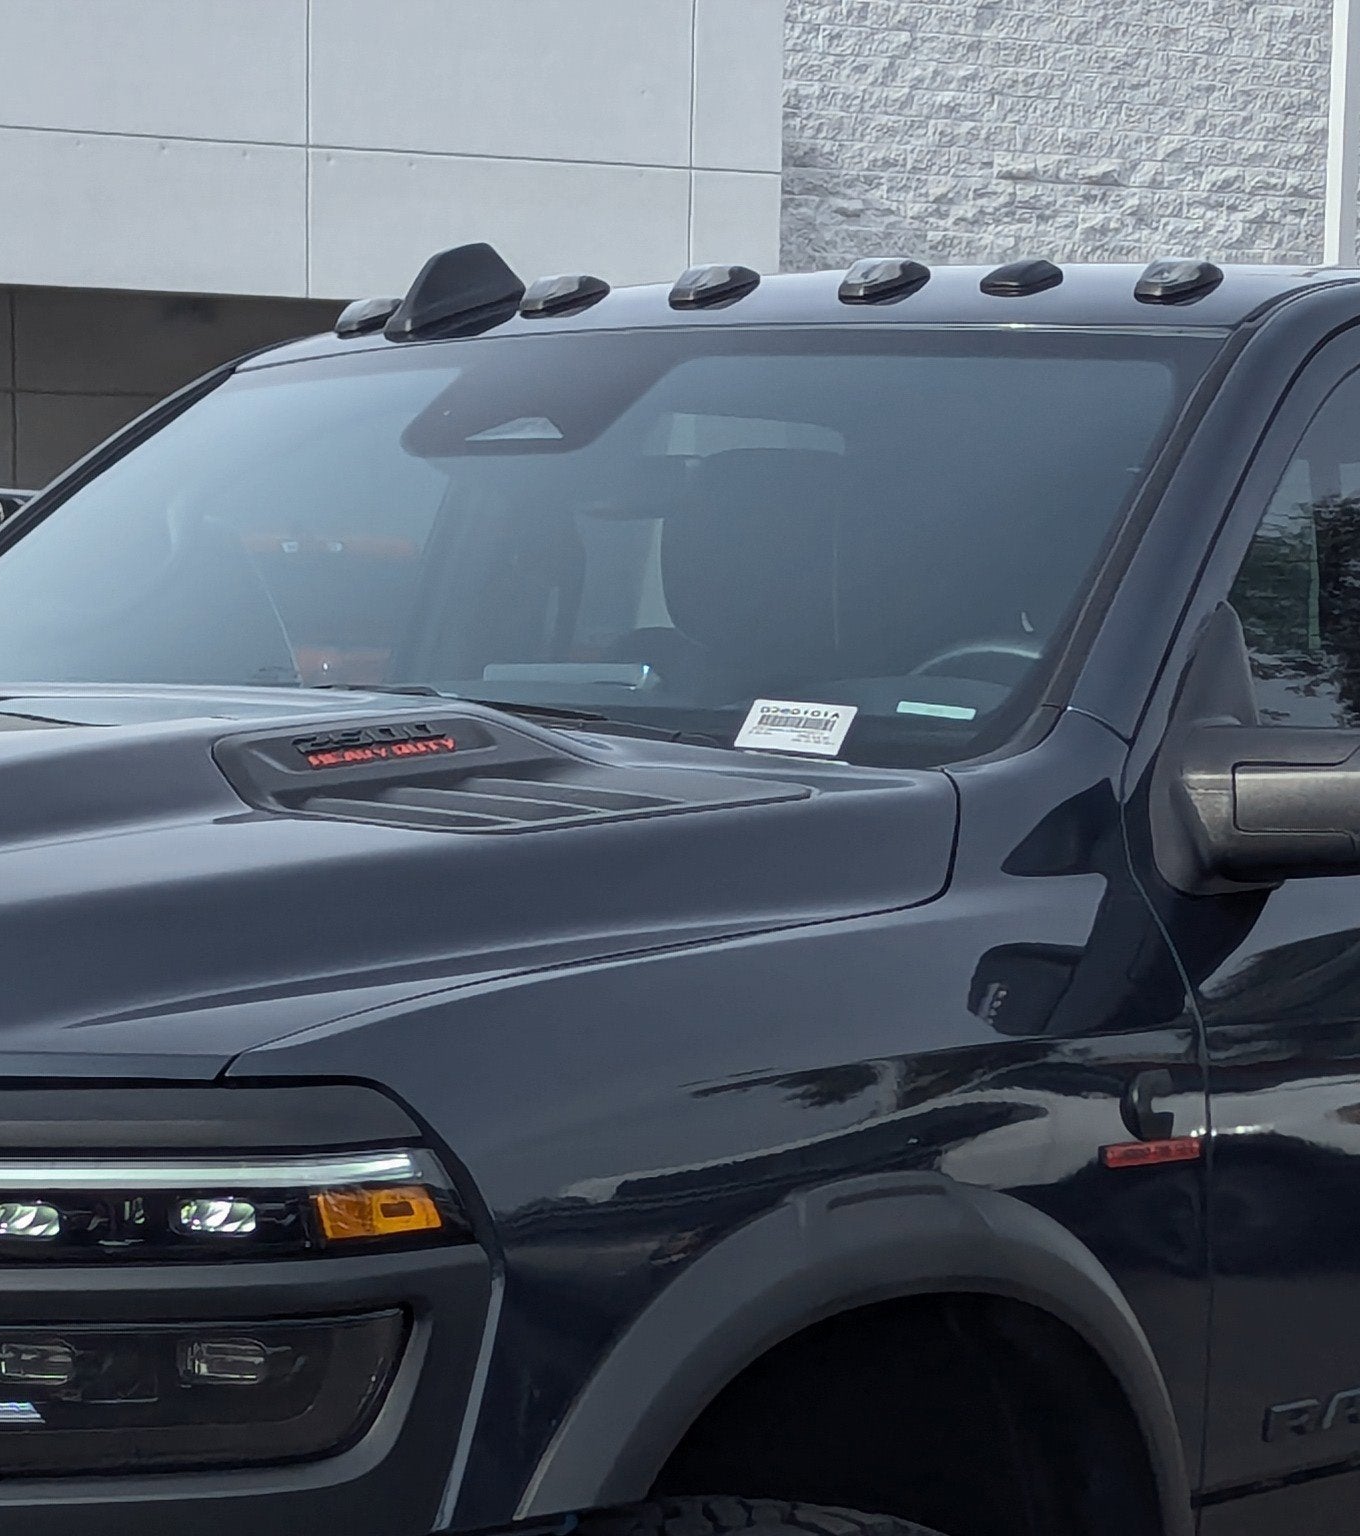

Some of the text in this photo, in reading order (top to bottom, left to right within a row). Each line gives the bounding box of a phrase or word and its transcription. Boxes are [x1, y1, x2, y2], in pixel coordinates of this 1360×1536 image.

[292, 721, 446, 754] 2500
[307, 737, 456, 767] HEAVY DUTY
